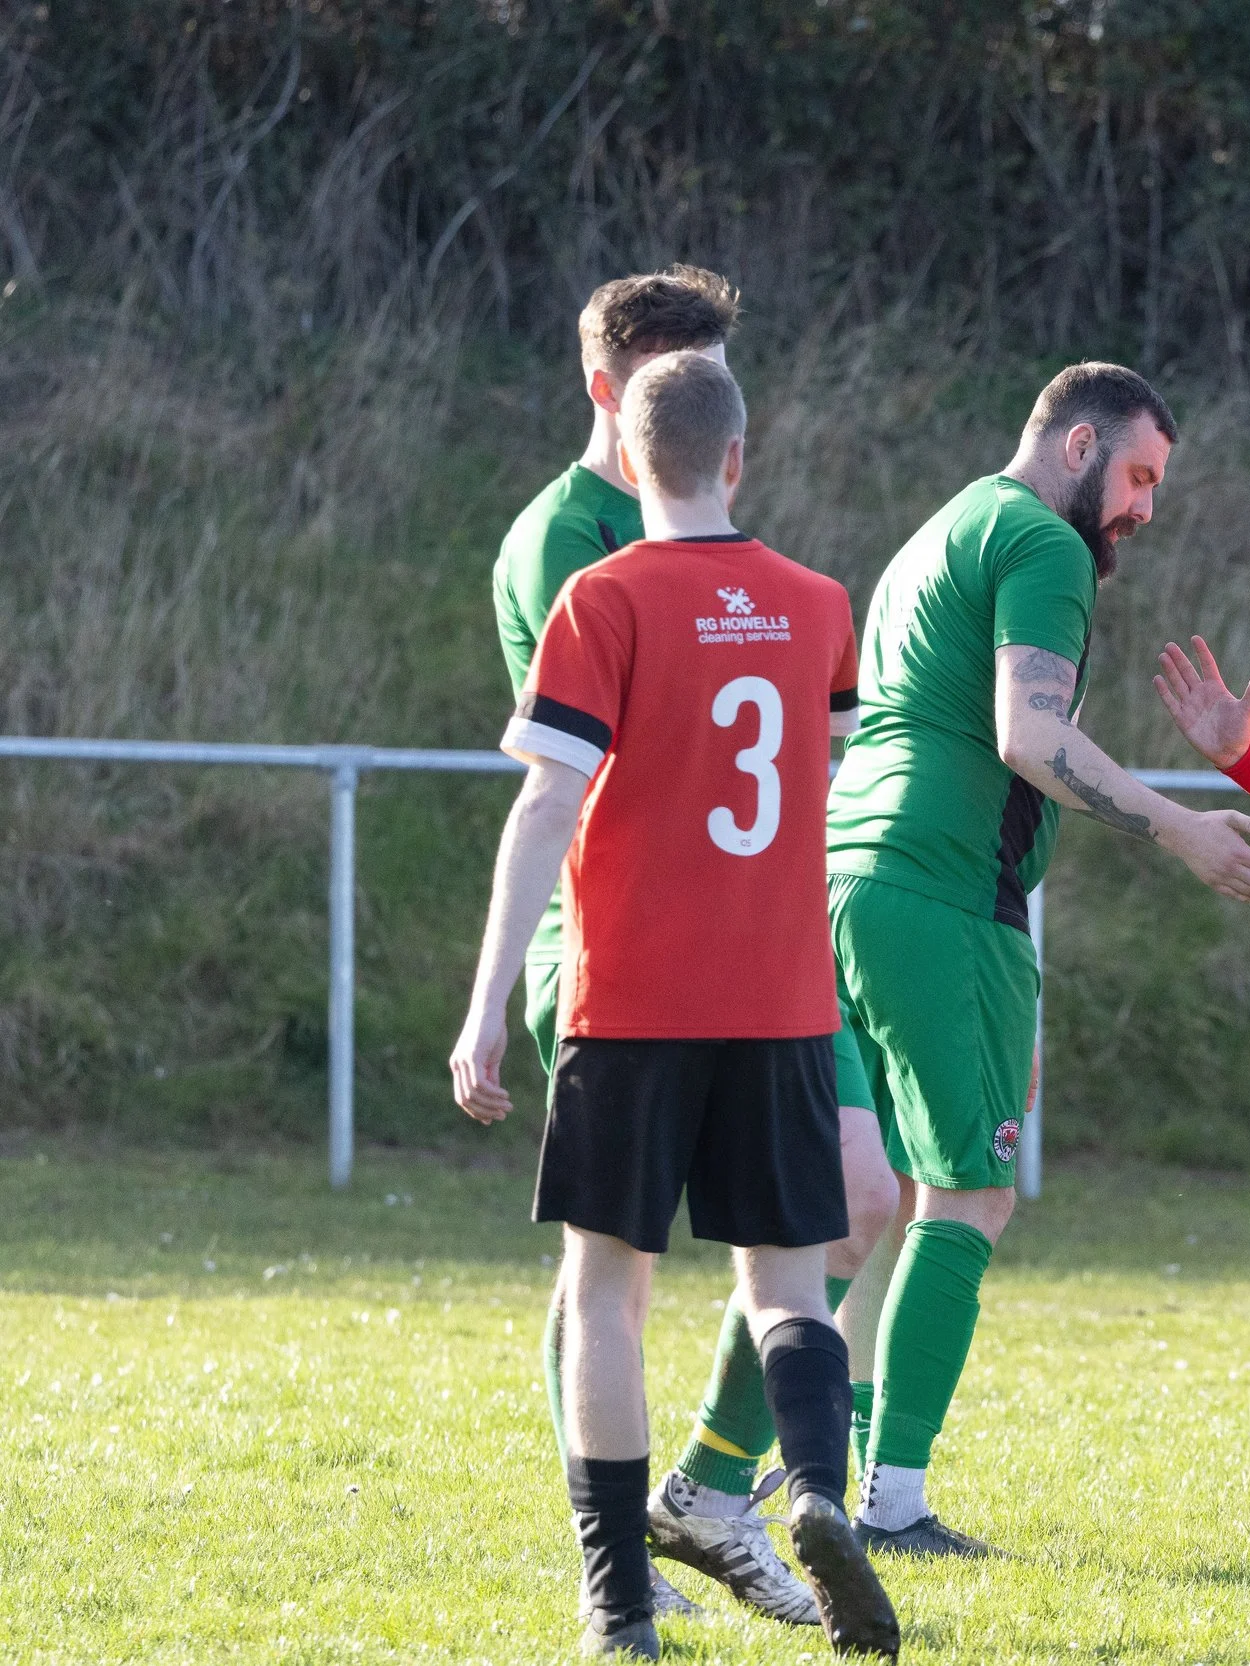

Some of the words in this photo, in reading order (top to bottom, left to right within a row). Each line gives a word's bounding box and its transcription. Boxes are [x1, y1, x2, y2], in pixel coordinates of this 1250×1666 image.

[695, 617, 718, 632] RG
[720, 615, 790, 630] HOWELLS
[698, 631, 744, 645] cleaning
[745, 630, 791, 641] services
[707, 676, 784, 857] 3
